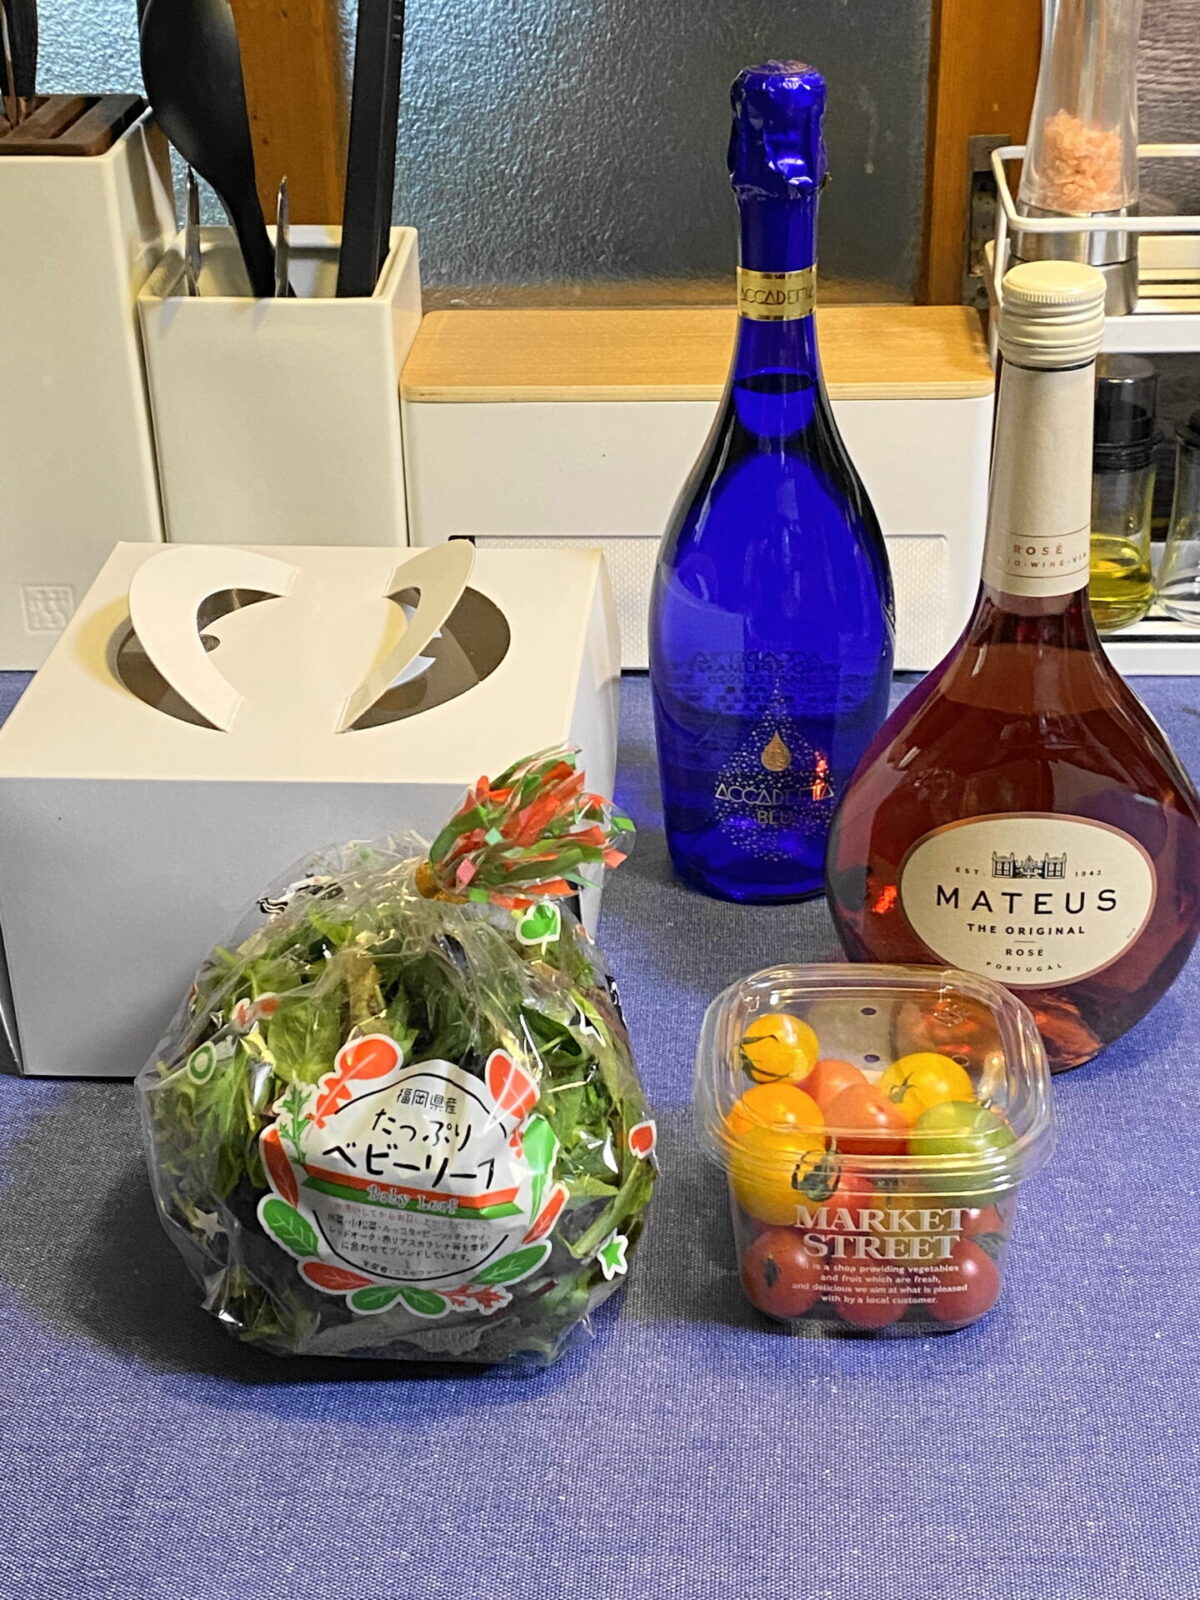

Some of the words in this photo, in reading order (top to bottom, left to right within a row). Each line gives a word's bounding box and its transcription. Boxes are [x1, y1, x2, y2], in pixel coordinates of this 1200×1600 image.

[1013, 543, 1063, 556] ROSÉ
[936, 884, 1117, 915] MATEUS
[967, 923, 997, 934] THE
[1005, 926, 1085, 936] ORIGINAL
[985, 961, 1063, 972] PORTUGAL
[397, 1088, 456, 1114] 福岡県産
[372, 1108, 471, 1151] たっぷり
[793, 1204, 970, 1232] MARKET
[803, 1233, 960, 1260] STREET
[833, 1264, 856, 1273] shop
[859, 1265, 905, 1274] providing
[908, 1264, 959, 1274] vegetables
[865, 1275, 893, 1283] which
[812, 1283, 852, 1292] delicious
[869, 1285, 887, 1293] aim
[900, 1285, 921, 1293] what
[923, 1285, 931, 1293] is
[933, 1283, 968, 1294] pleased
[843, 1295, 855, 1304] by
[866, 1296, 890, 1304] local
